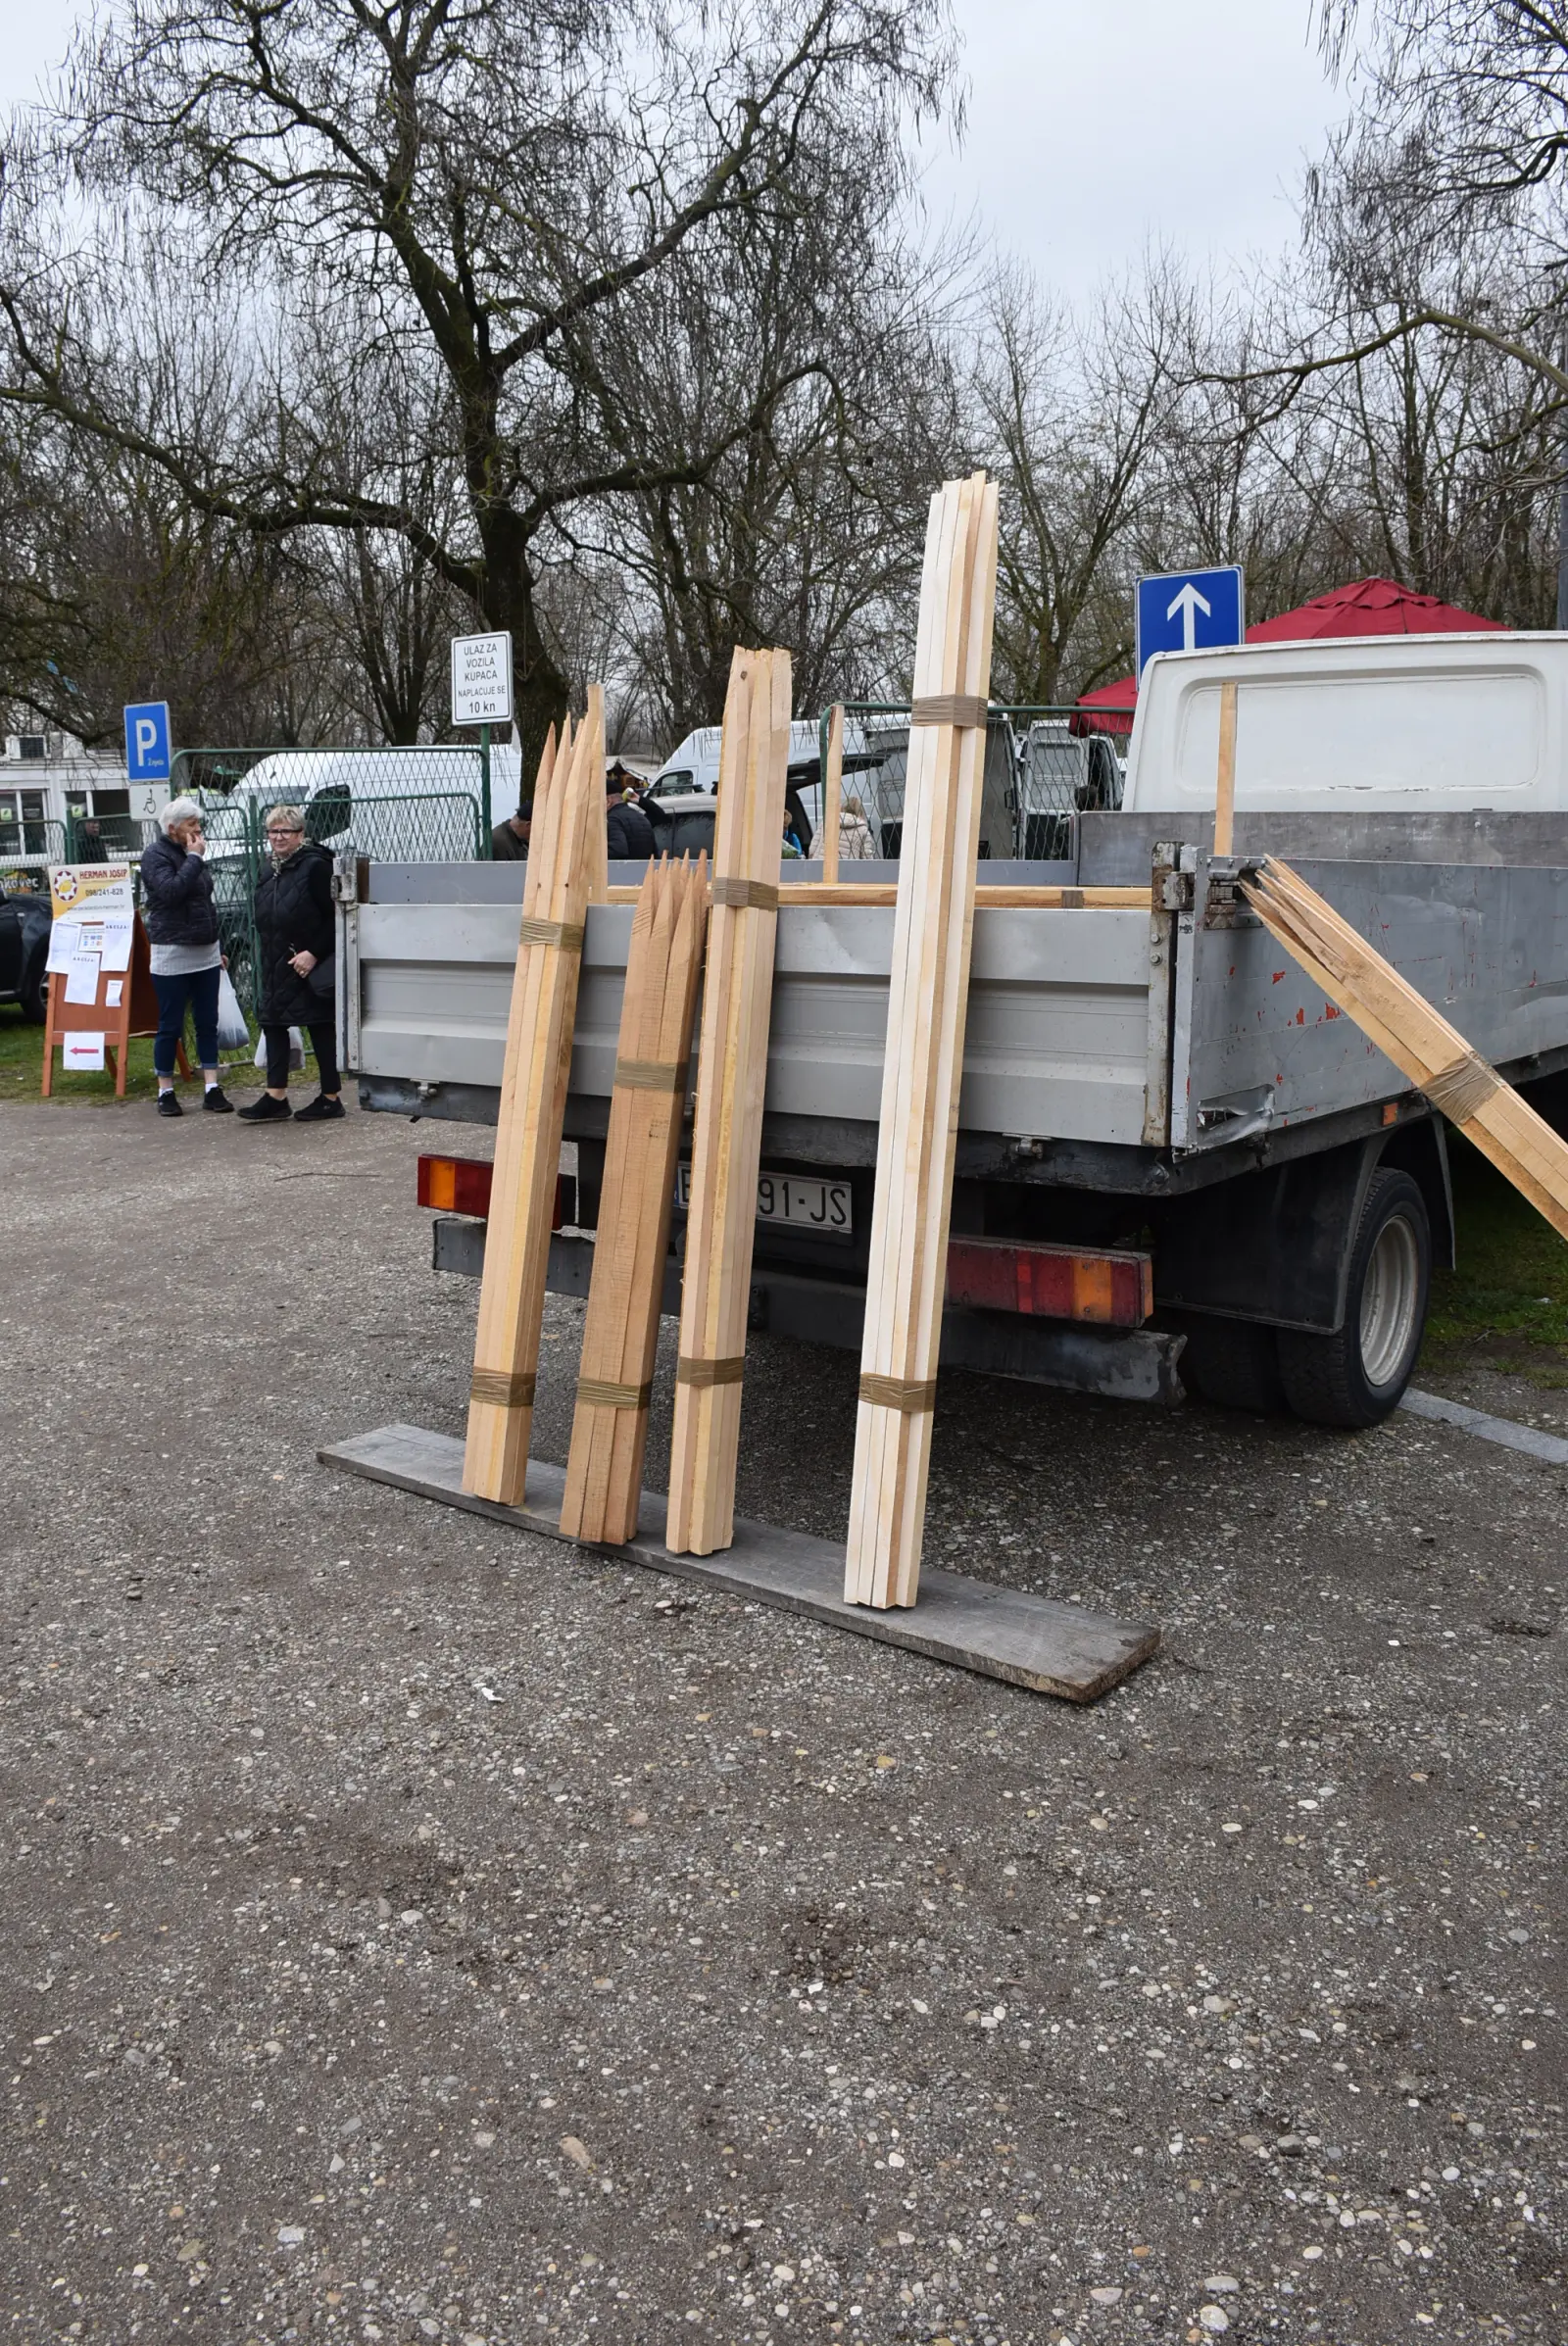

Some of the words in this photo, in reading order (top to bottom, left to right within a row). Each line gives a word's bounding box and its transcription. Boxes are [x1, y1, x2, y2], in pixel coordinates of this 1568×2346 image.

[464, 644, 485, 656] ULAZ
[487, 644, 497, 653] ZA
[466, 657, 495, 668] VOZILA
[465, 670, 498, 682] KUPACA
[469, 702, 480, 713] 10
[483, 701, 495, 712] kn
[135, 718, 158, 767] P
[78, 869, 108, 880] HERMAN
[109, 868, 128, 878] JOSIP
